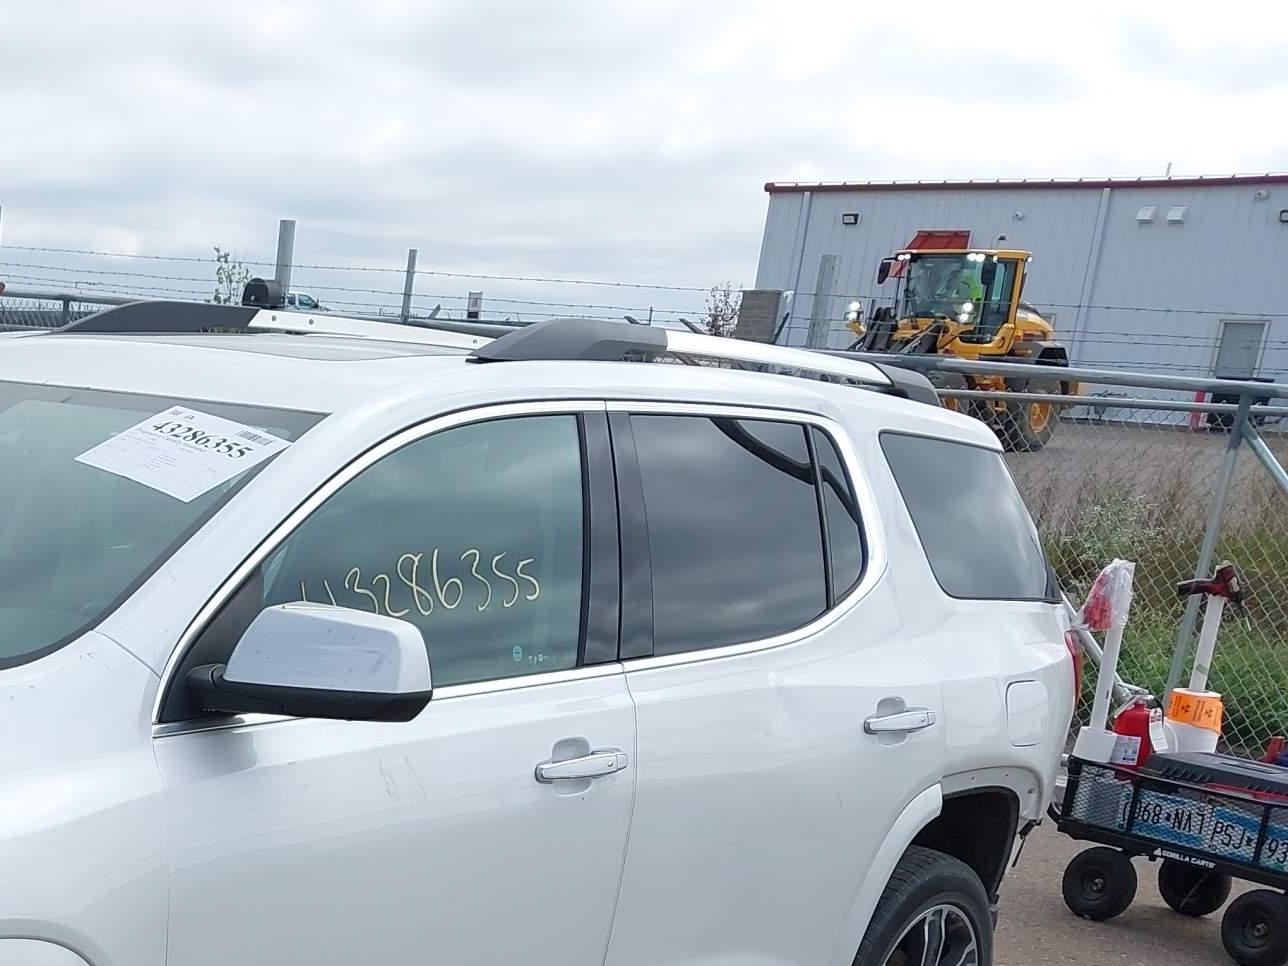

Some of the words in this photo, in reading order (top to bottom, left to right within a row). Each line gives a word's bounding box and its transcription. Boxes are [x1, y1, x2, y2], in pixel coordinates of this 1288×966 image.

[152, 420, 253, 459] 43286355
[1210, 820, 1247, 850] PSJ
[1162, 849, 1190, 863] GORILLA
